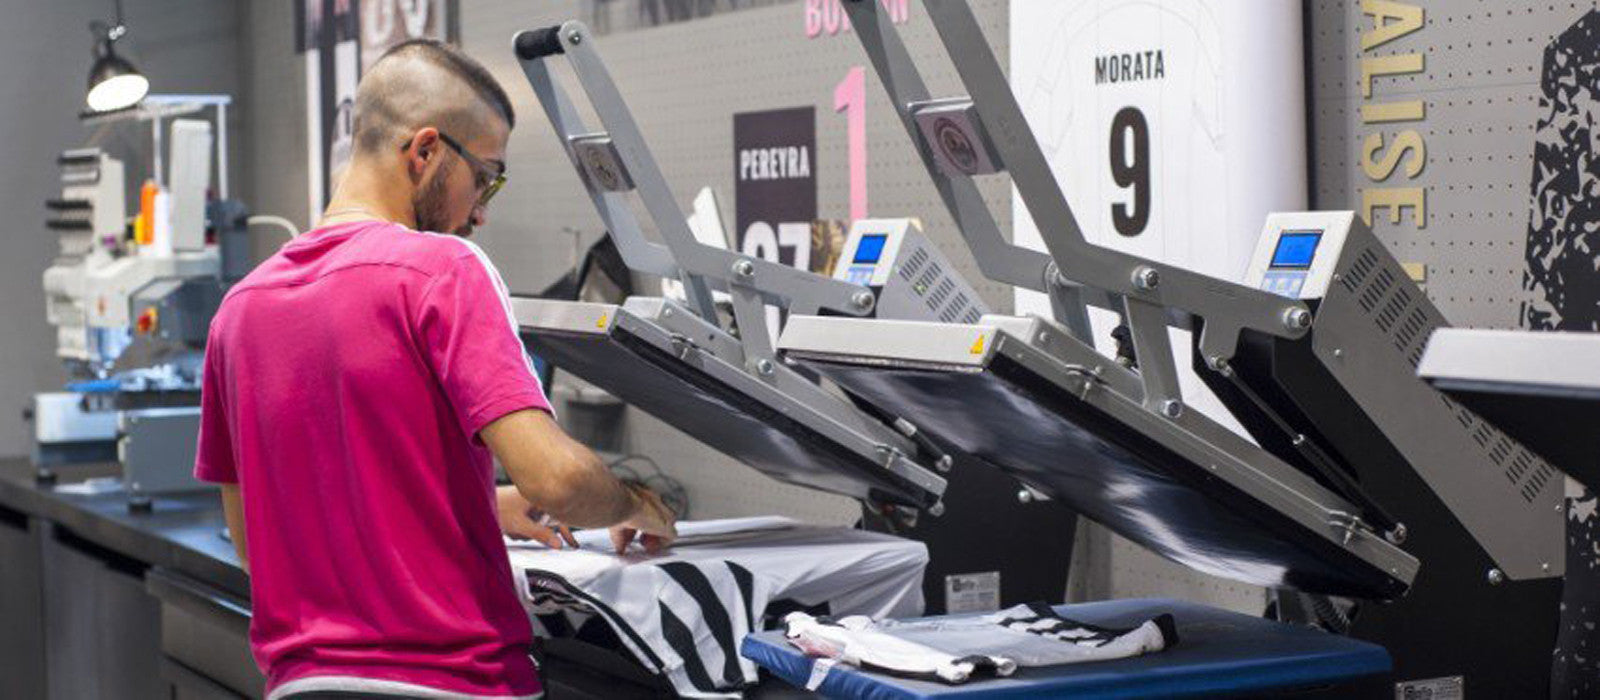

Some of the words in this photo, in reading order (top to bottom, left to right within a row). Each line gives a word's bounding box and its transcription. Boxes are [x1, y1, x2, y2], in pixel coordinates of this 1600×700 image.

[1095, 49, 1165, 85] MORATA
[1362, 0, 1427, 229] ALISE
[740, 146, 810, 180] PEREYRA
[834, 66, 867, 222] 1
[1109, 106, 1151, 237] 9
